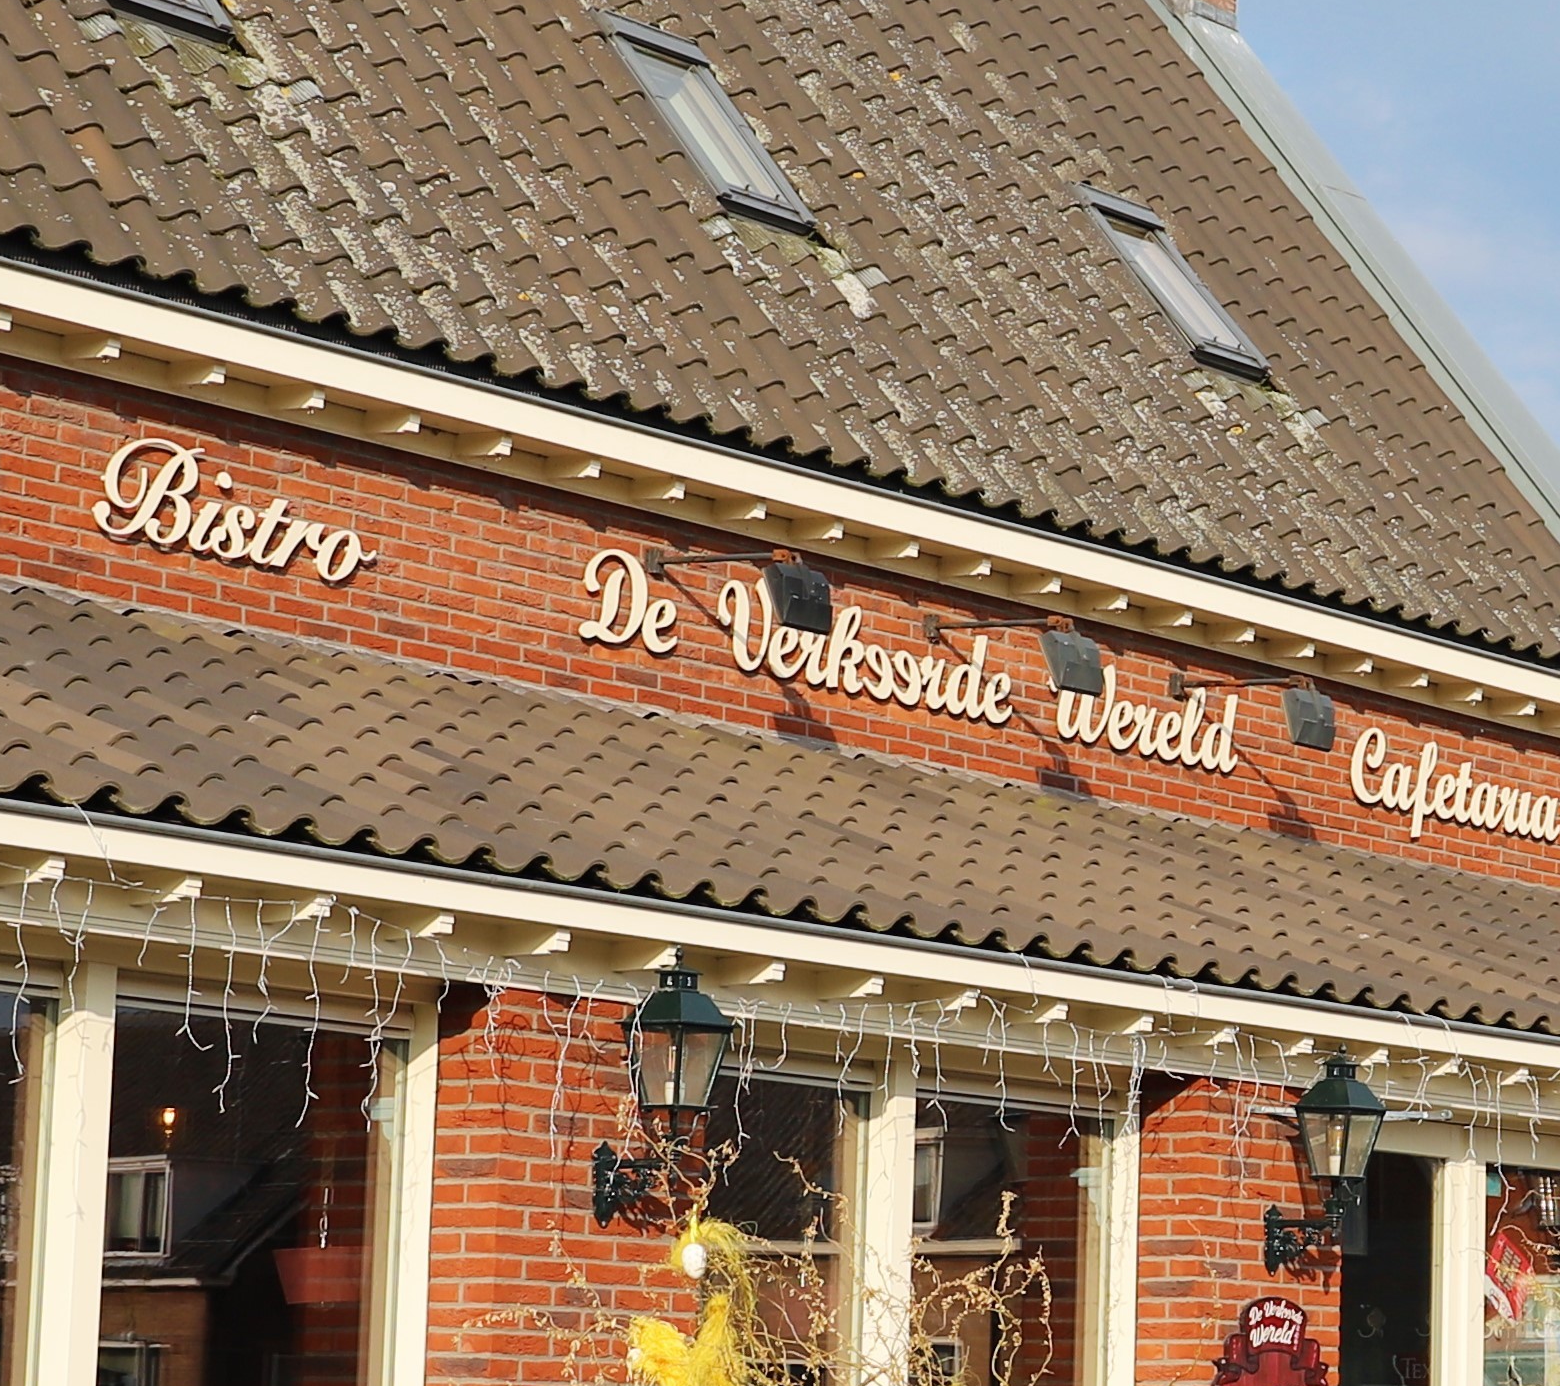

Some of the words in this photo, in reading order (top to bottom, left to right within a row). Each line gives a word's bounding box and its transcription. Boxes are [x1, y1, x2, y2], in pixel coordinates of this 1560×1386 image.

[92, 438, 377, 581] Bistro
[579, 549, 680, 653] De
[1048, 664, 1239, 773] Wereld
[1350, 727, 1560, 842] Cafetaria
[1249, 1306, 1263, 1325] De
[1250, 1320, 1296, 1348] Wereld
